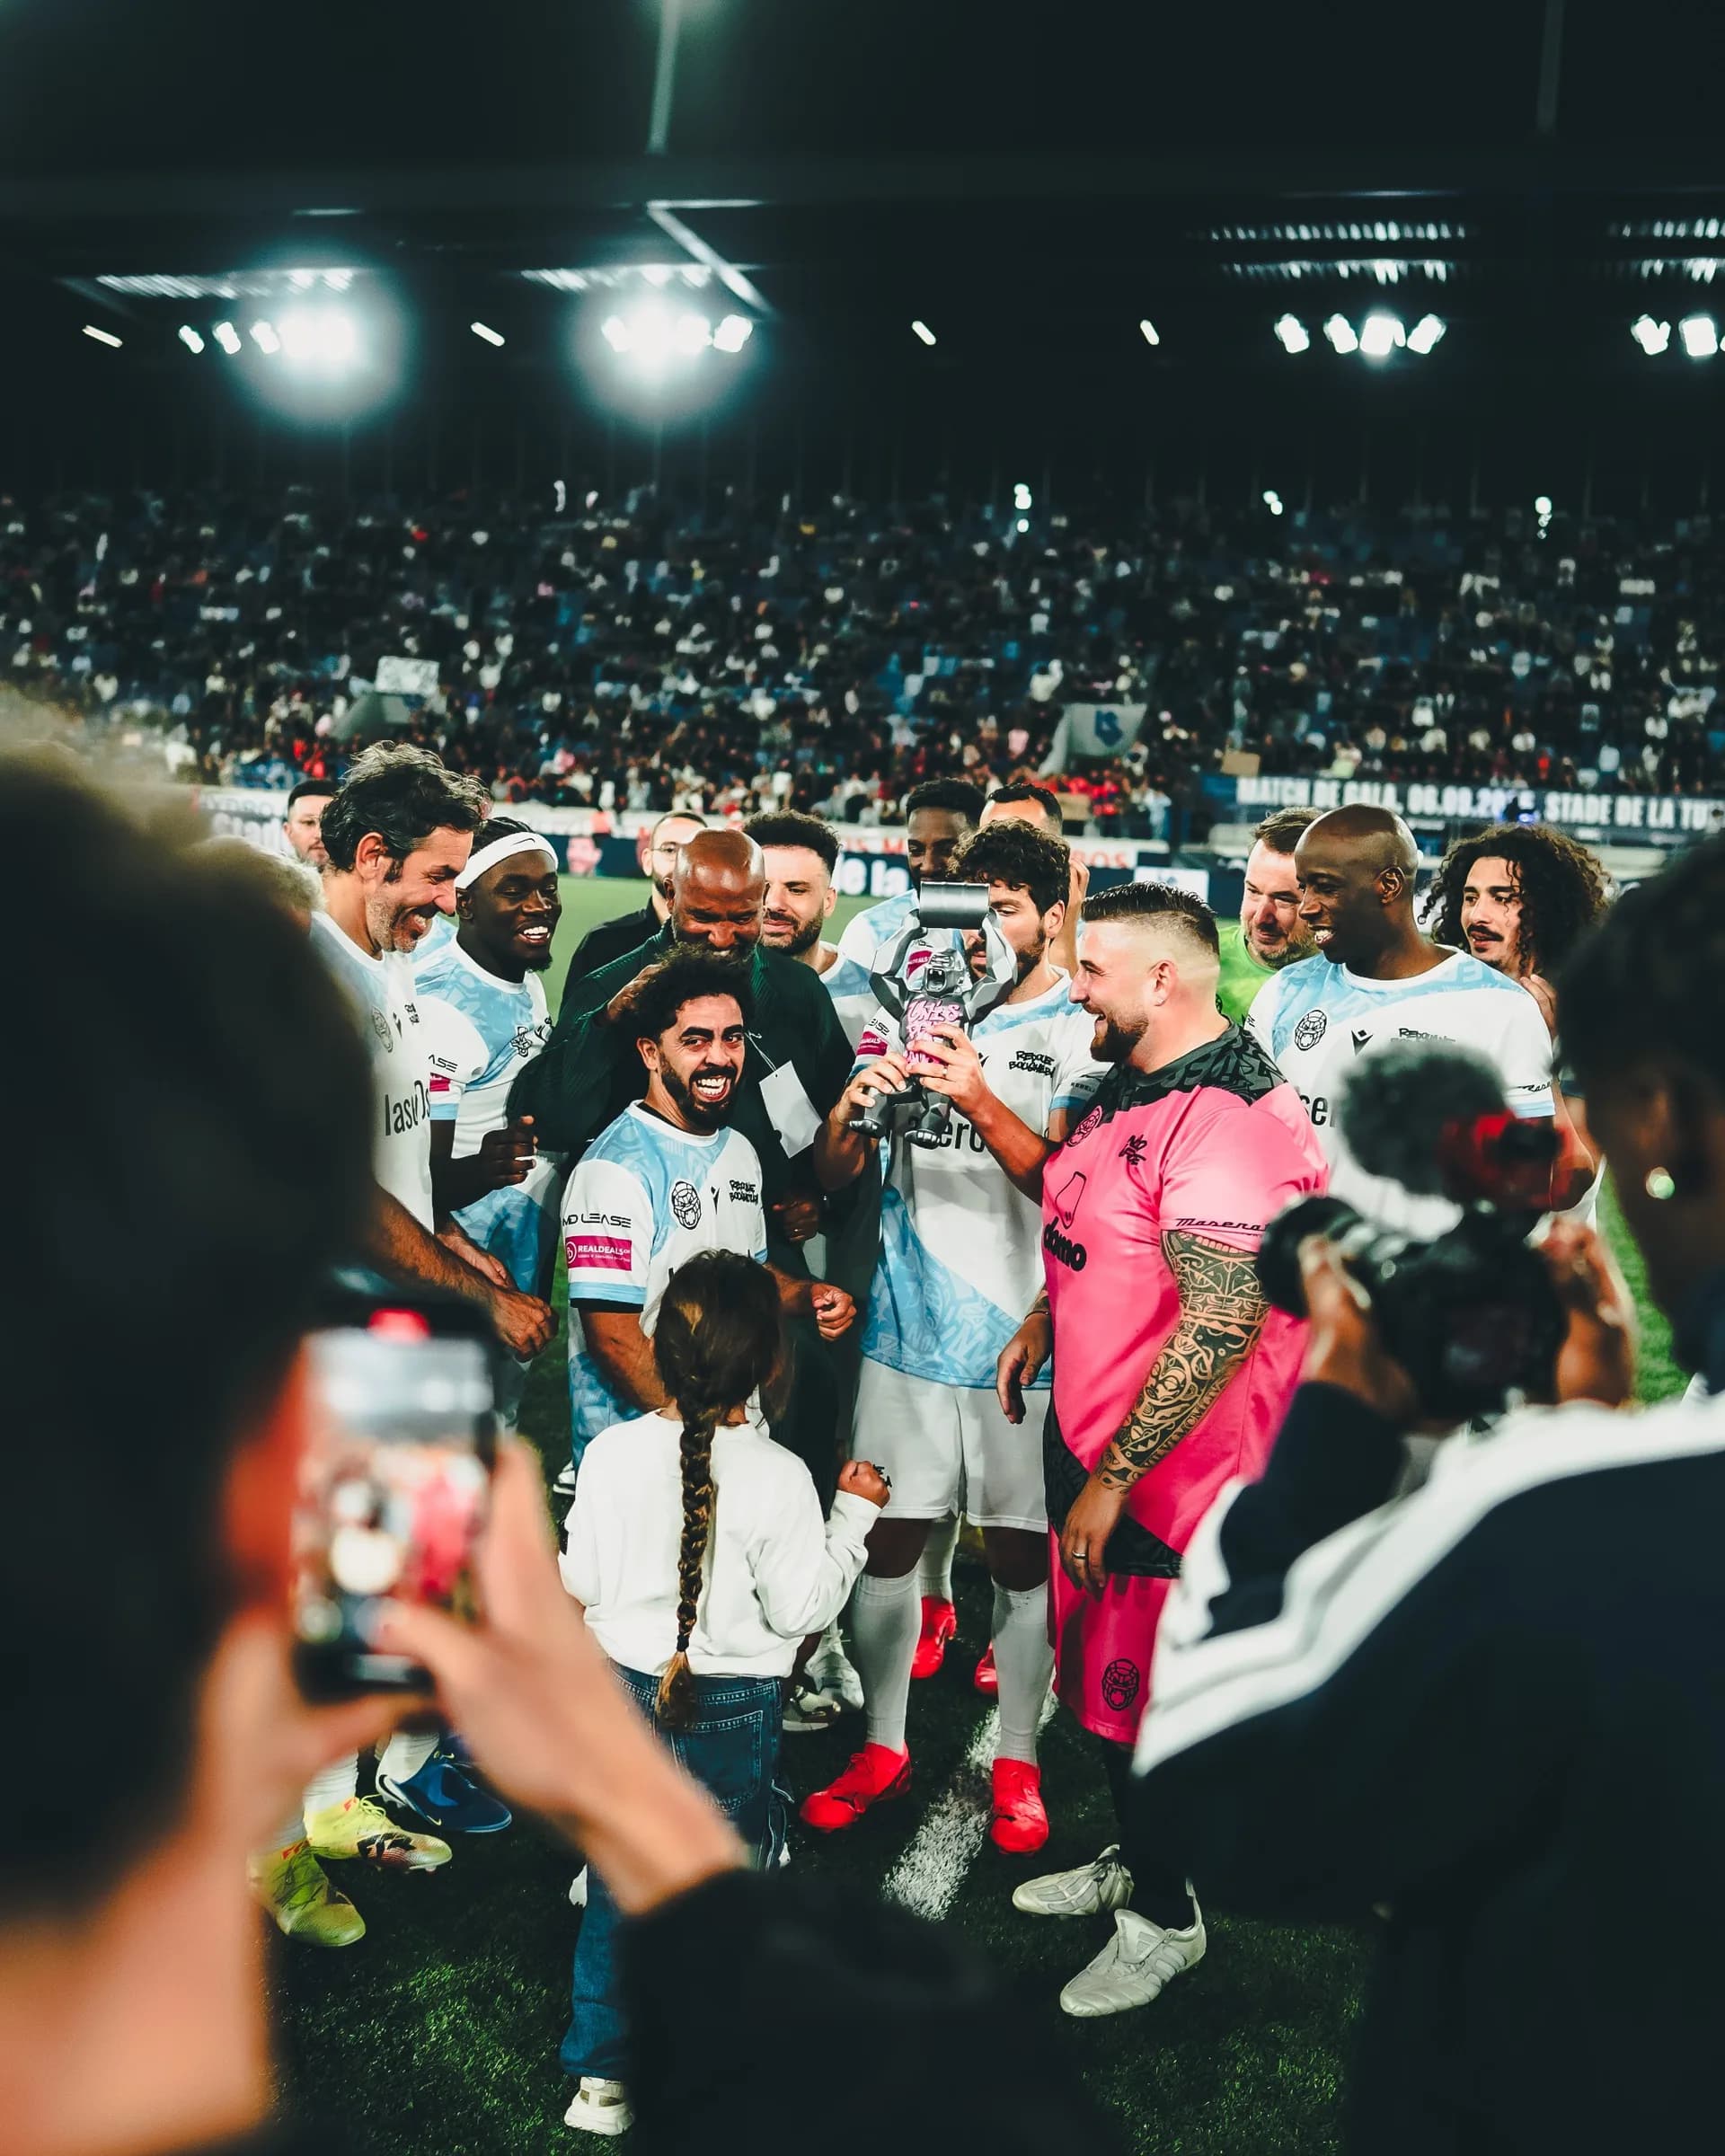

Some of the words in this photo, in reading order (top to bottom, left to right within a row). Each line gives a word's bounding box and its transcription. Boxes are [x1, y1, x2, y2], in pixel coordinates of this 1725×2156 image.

[1544, 791, 1612, 826] STADE
[1615, 795, 1644, 827] DE
[1647, 797, 1675, 828] LA
[580, 1213, 632, 1229] LEASE
